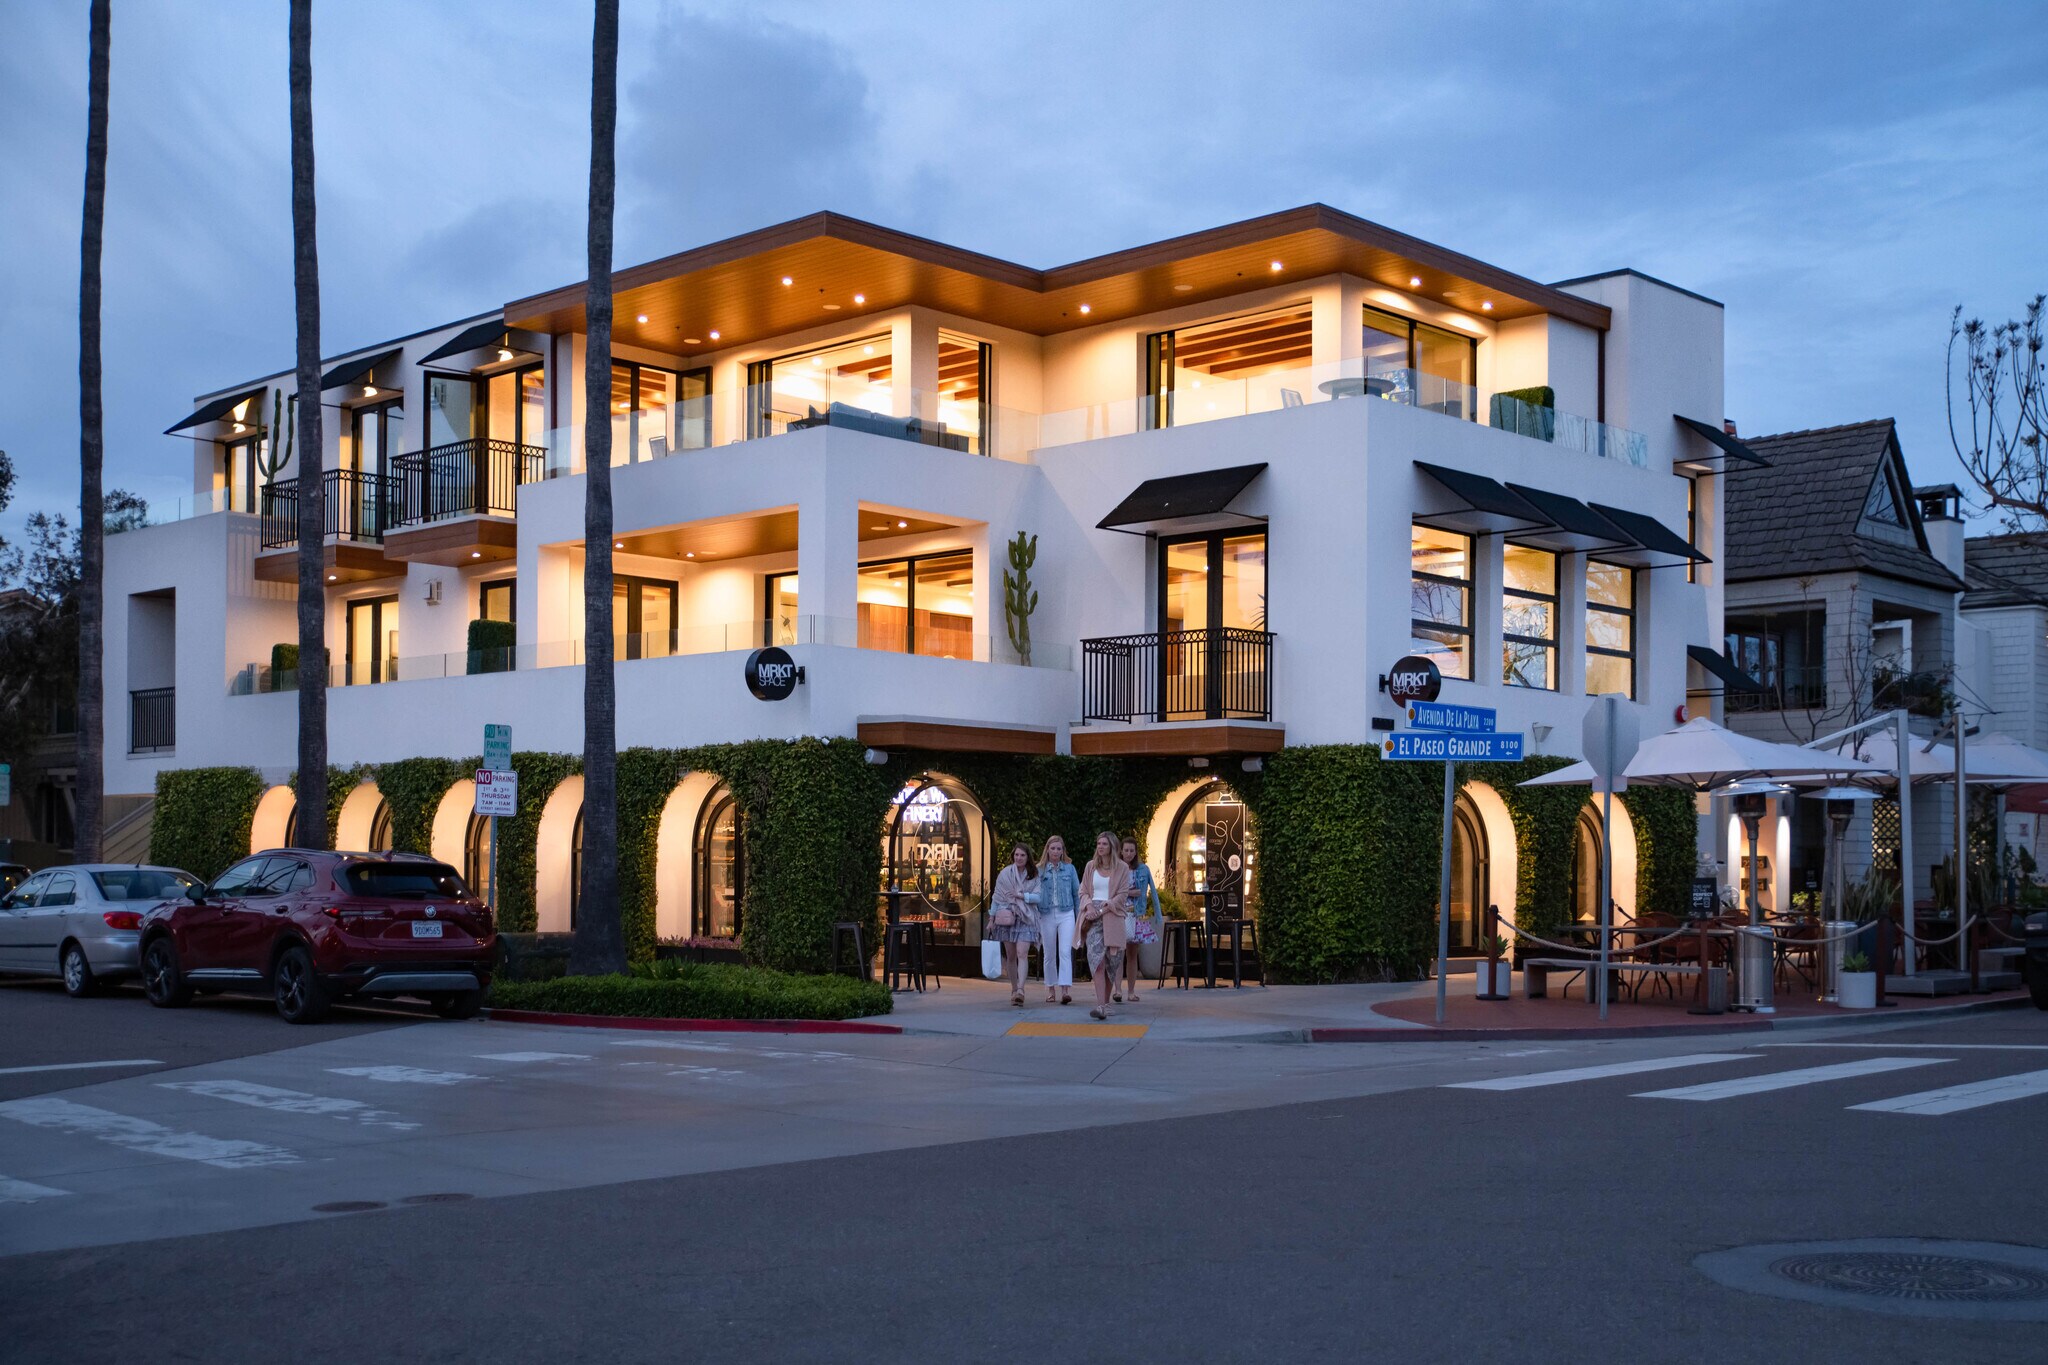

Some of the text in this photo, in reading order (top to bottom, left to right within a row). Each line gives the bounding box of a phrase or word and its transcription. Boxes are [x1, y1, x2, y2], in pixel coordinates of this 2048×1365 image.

[758, 663, 793, 678] MRKT
[758, 676, 786, 686] SPACE
[1393, 672, 1429, 686] MRKT
[1392, 685, 1420, 695] SPACE
[1418, 706, 1479, 730] AVENIDA DE LA PLAYA
[486, 725, 494, 737] 90
[486, 740, 509, 750] PARKING
[1399, 737, 1491, 756] EL PASEO GRANDE
[1500, 741, 1518, 749] 8100
[478, 772, 514, 783] NO PARKING
